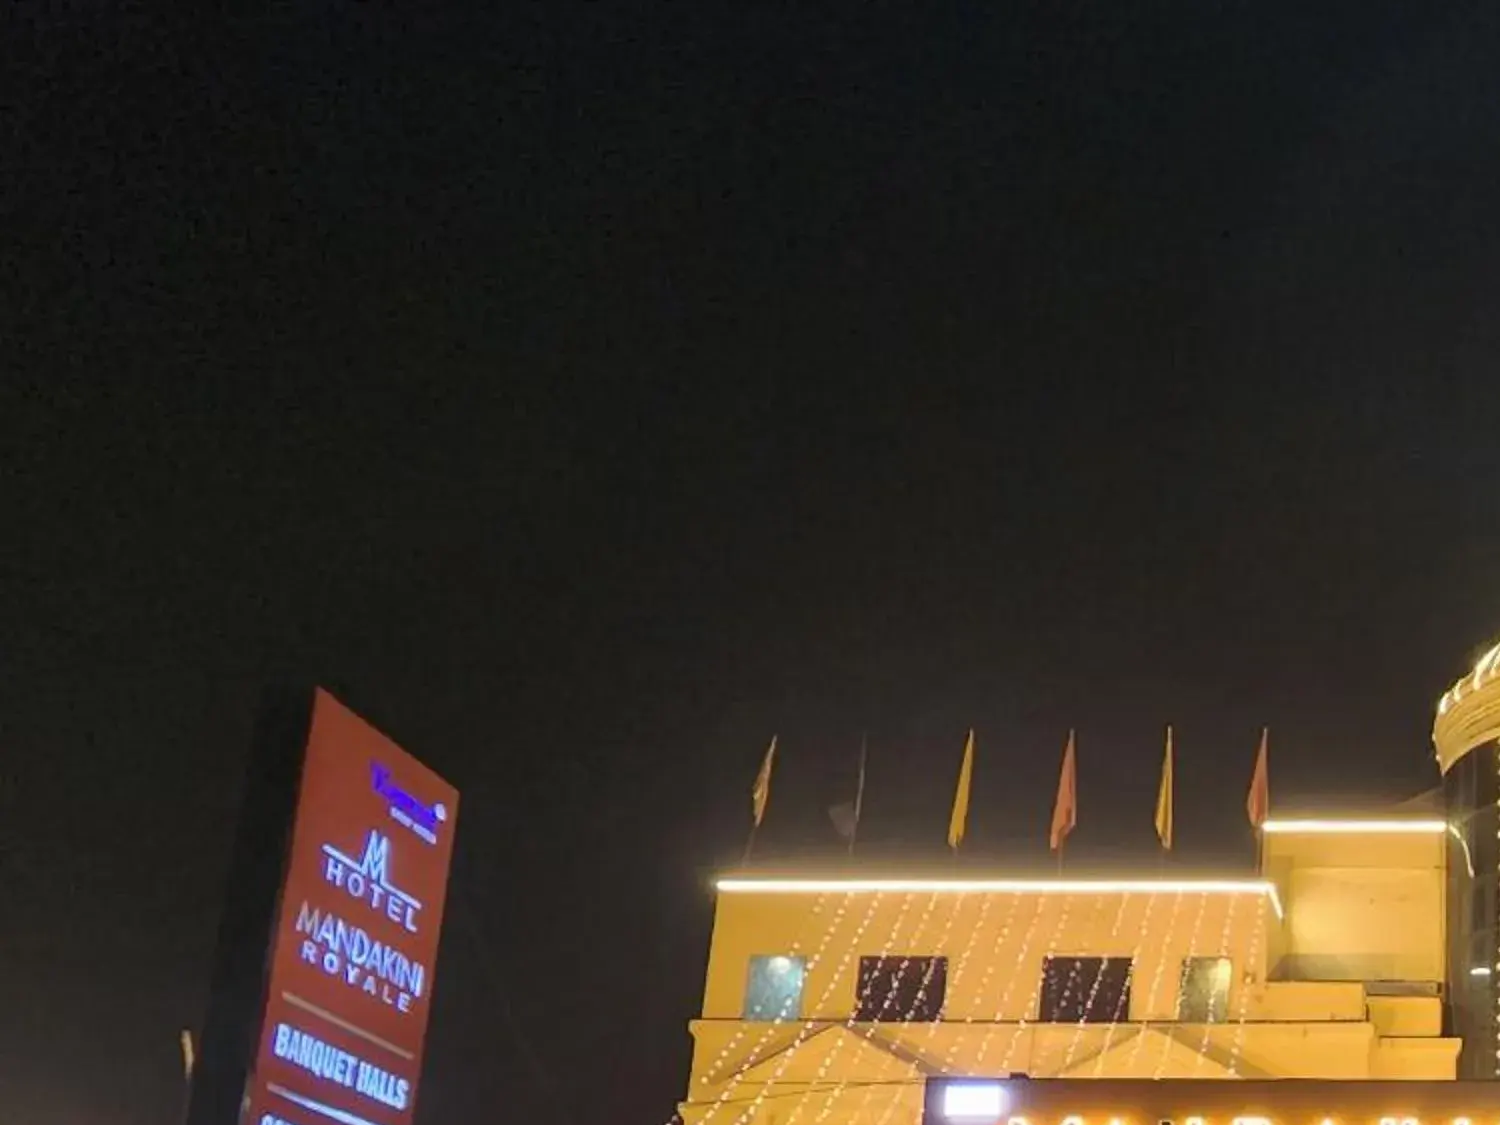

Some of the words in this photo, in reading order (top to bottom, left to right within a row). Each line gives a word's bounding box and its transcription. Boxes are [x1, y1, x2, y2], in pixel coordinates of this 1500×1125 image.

[326, 858, 418, 932] HOTEL
[296, 900, 425, 998] MANDAKINI
[301, 941, 413, 1012] ROYALE
[273, 1023, 357, 1088] BANQUET
[355, 1060, 410, 1110] HALLS
